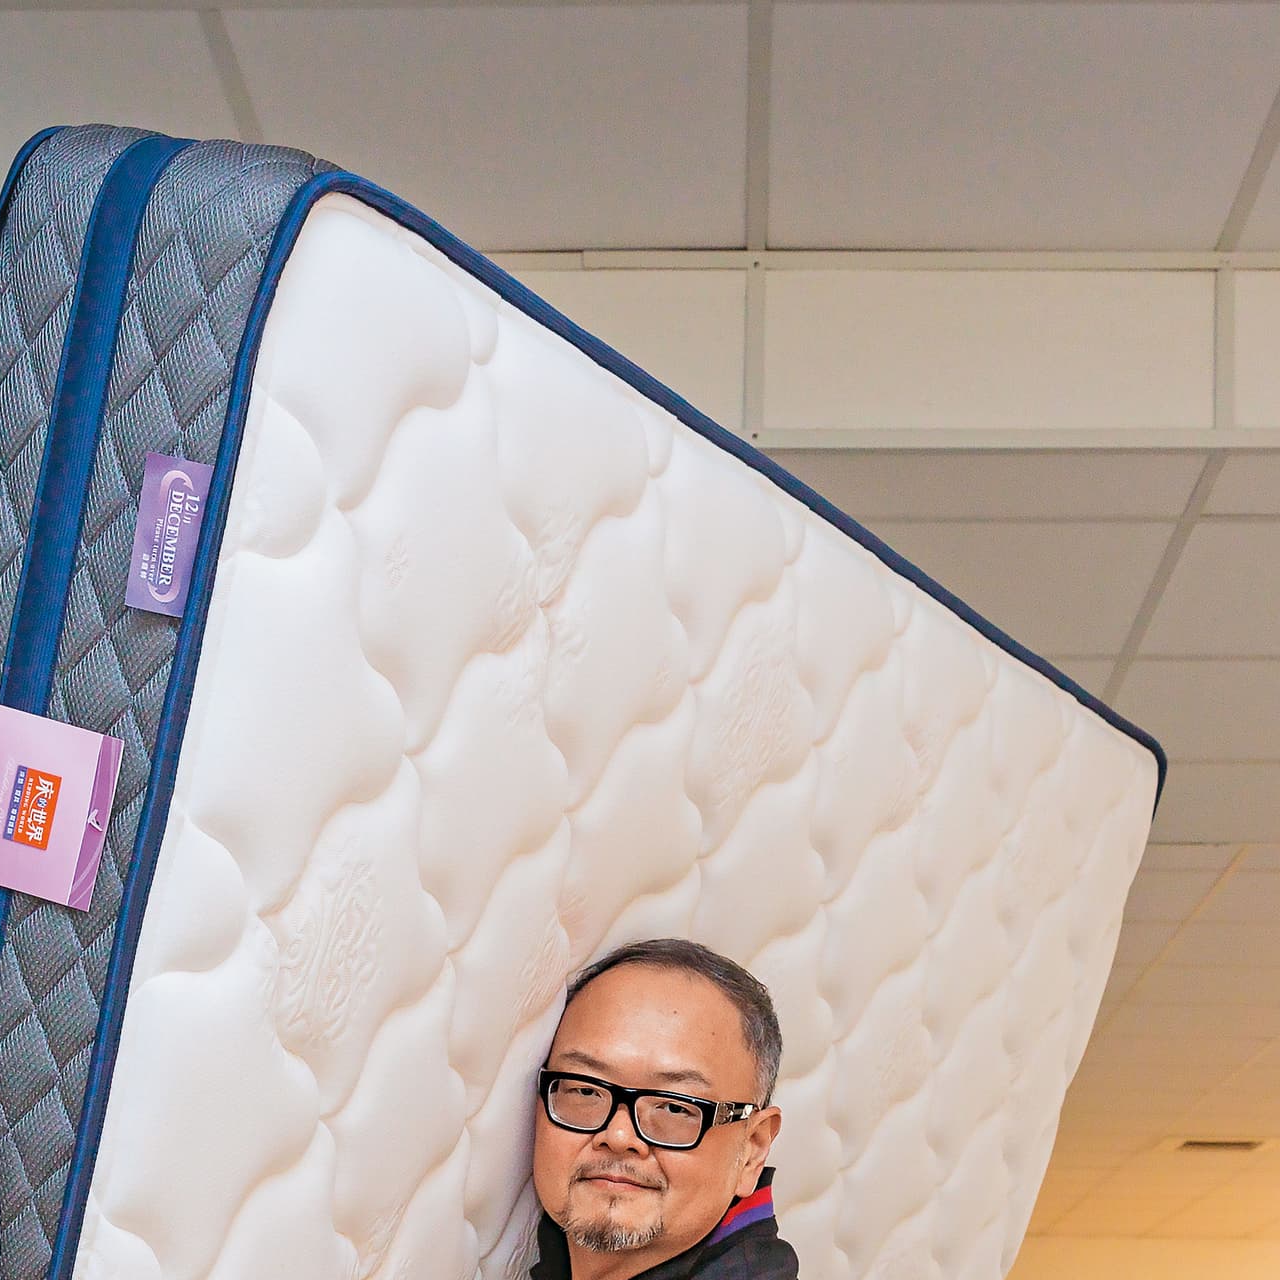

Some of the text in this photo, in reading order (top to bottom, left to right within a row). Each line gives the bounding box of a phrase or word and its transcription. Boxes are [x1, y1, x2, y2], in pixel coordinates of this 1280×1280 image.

[158, 491, 185, 586] DECEMBER
[26, 776, 55, 842] 床的世界
